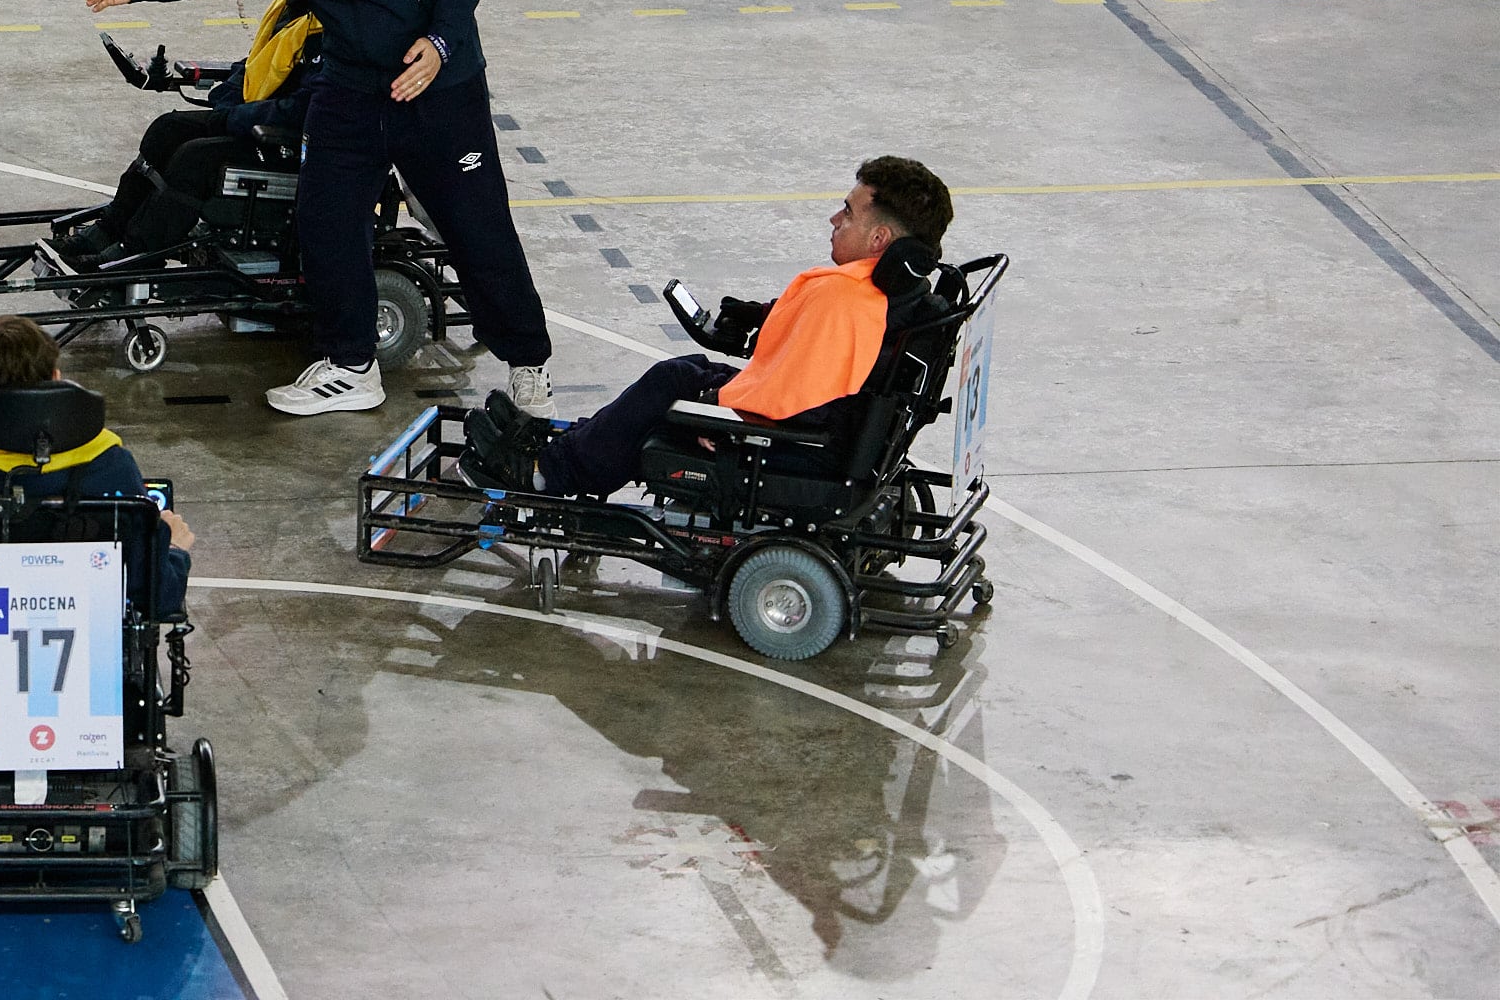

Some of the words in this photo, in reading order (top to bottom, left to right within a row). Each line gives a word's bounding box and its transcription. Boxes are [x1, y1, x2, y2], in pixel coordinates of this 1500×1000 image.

[964, 364, 982, 434] 13
[20, 554, 58, 565] POWER
[10, 596, 76, 611] AROCENA
[10, 628, 76, 694] 17
